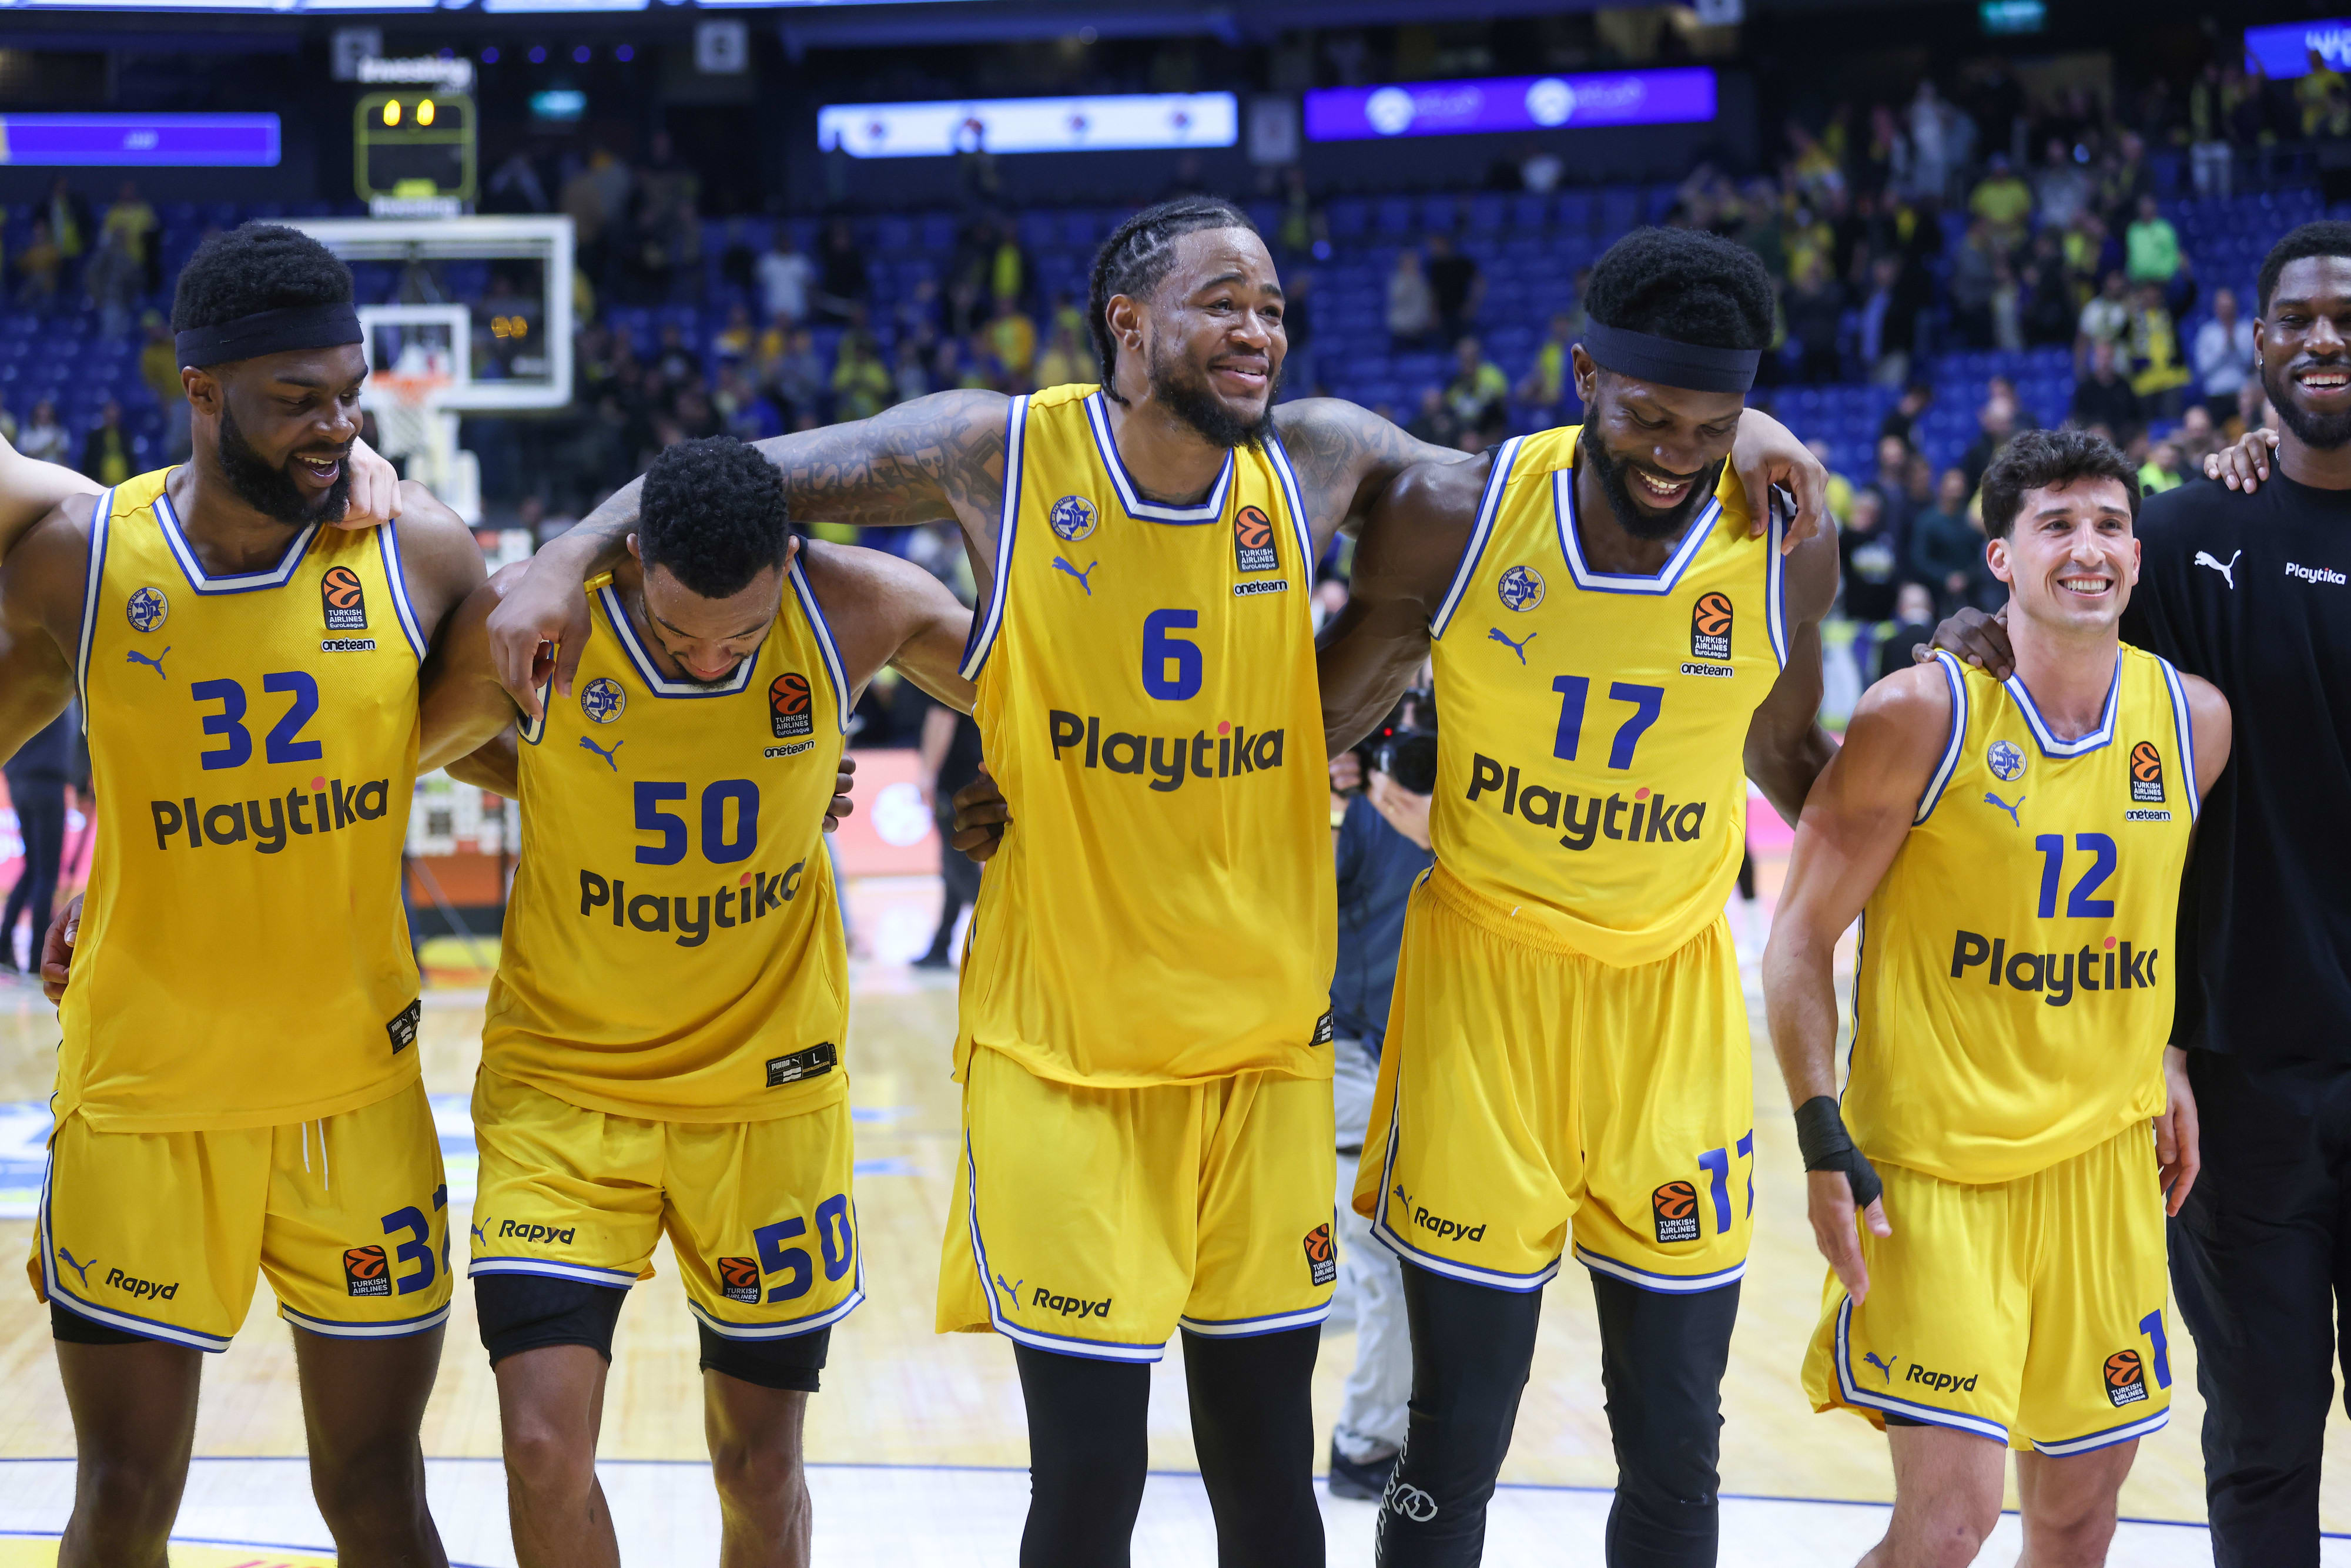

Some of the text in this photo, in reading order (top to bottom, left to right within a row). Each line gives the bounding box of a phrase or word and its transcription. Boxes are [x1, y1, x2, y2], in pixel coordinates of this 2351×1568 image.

[1240, 548, 1273, 557] TURKISH
[1241, 555, 1274, 564] AIRLINES
[2285, 562, 2346, 585] Playtika
[1234, 581, 1287, 594] oneteam
[322, 639, 376, 651] oneteam
[1695, 635, 1728, 645] TURKISH
[1694, 649, 1727, 658] EuroLeague
[1695, 642, 1727, 652] AIRLINES
[1142, 609, 1203, 701] 6
[1682, 664, 1733, 676] oneteam
[192, 671, 322, 770] 32
[775, 713, 808, 723] TURKISH
[1552, 675, 1665, 770] 17
[776, 720, 809, 730] AIRLINES
[776, 727, 809, 736] EuroLeague
[764, 741, 815, 758] oneteam
[1050, 709, 1284, 792] Playtika
[2134, 781, 2161, 789] TURKISH
[1466, 752, 1706, 851] Playtika
[150, 776, 389, 854] Playtika
[2126, 809, 2170, 820] oneteam
[634, 779, 759, 865] 50
[2035, 833, 2116, 918] 12
[580, 857, 806, 948] Playtika
[771, 1059, 790, 1071] PUMA
[812, 1053, 820, 1064] L
[1414, 1206, 1486, 1242] Rapyd
[1659, 1218, 1695, 1228] TURKISH
[498, 1219, 575, 1245] Rapyd
[1660, 1225, 1696, 1235] AIRLINES
[1660, 1232, 1697, 1241] EuroLeague
[753, 1194, 852, 1304] 50
[1313, 1259, 1334, 1271] TURKISH
[1315, 1265, 1334, 1278] AIRLINES
[106, 1268, 179, 1300] Rapyd
[351, 1278, 387, 1288] TURKISH
[353, 1285, 388, 1294] AIRLINES
[1032, 1288, 1112, 1318] Rapyd
[1905, 1363, 1978, 1393] Rapyd
[2111, 1382, 2142, 1396] TURKISH
[2114, 1388, 2144, 1402] AIRLINES
